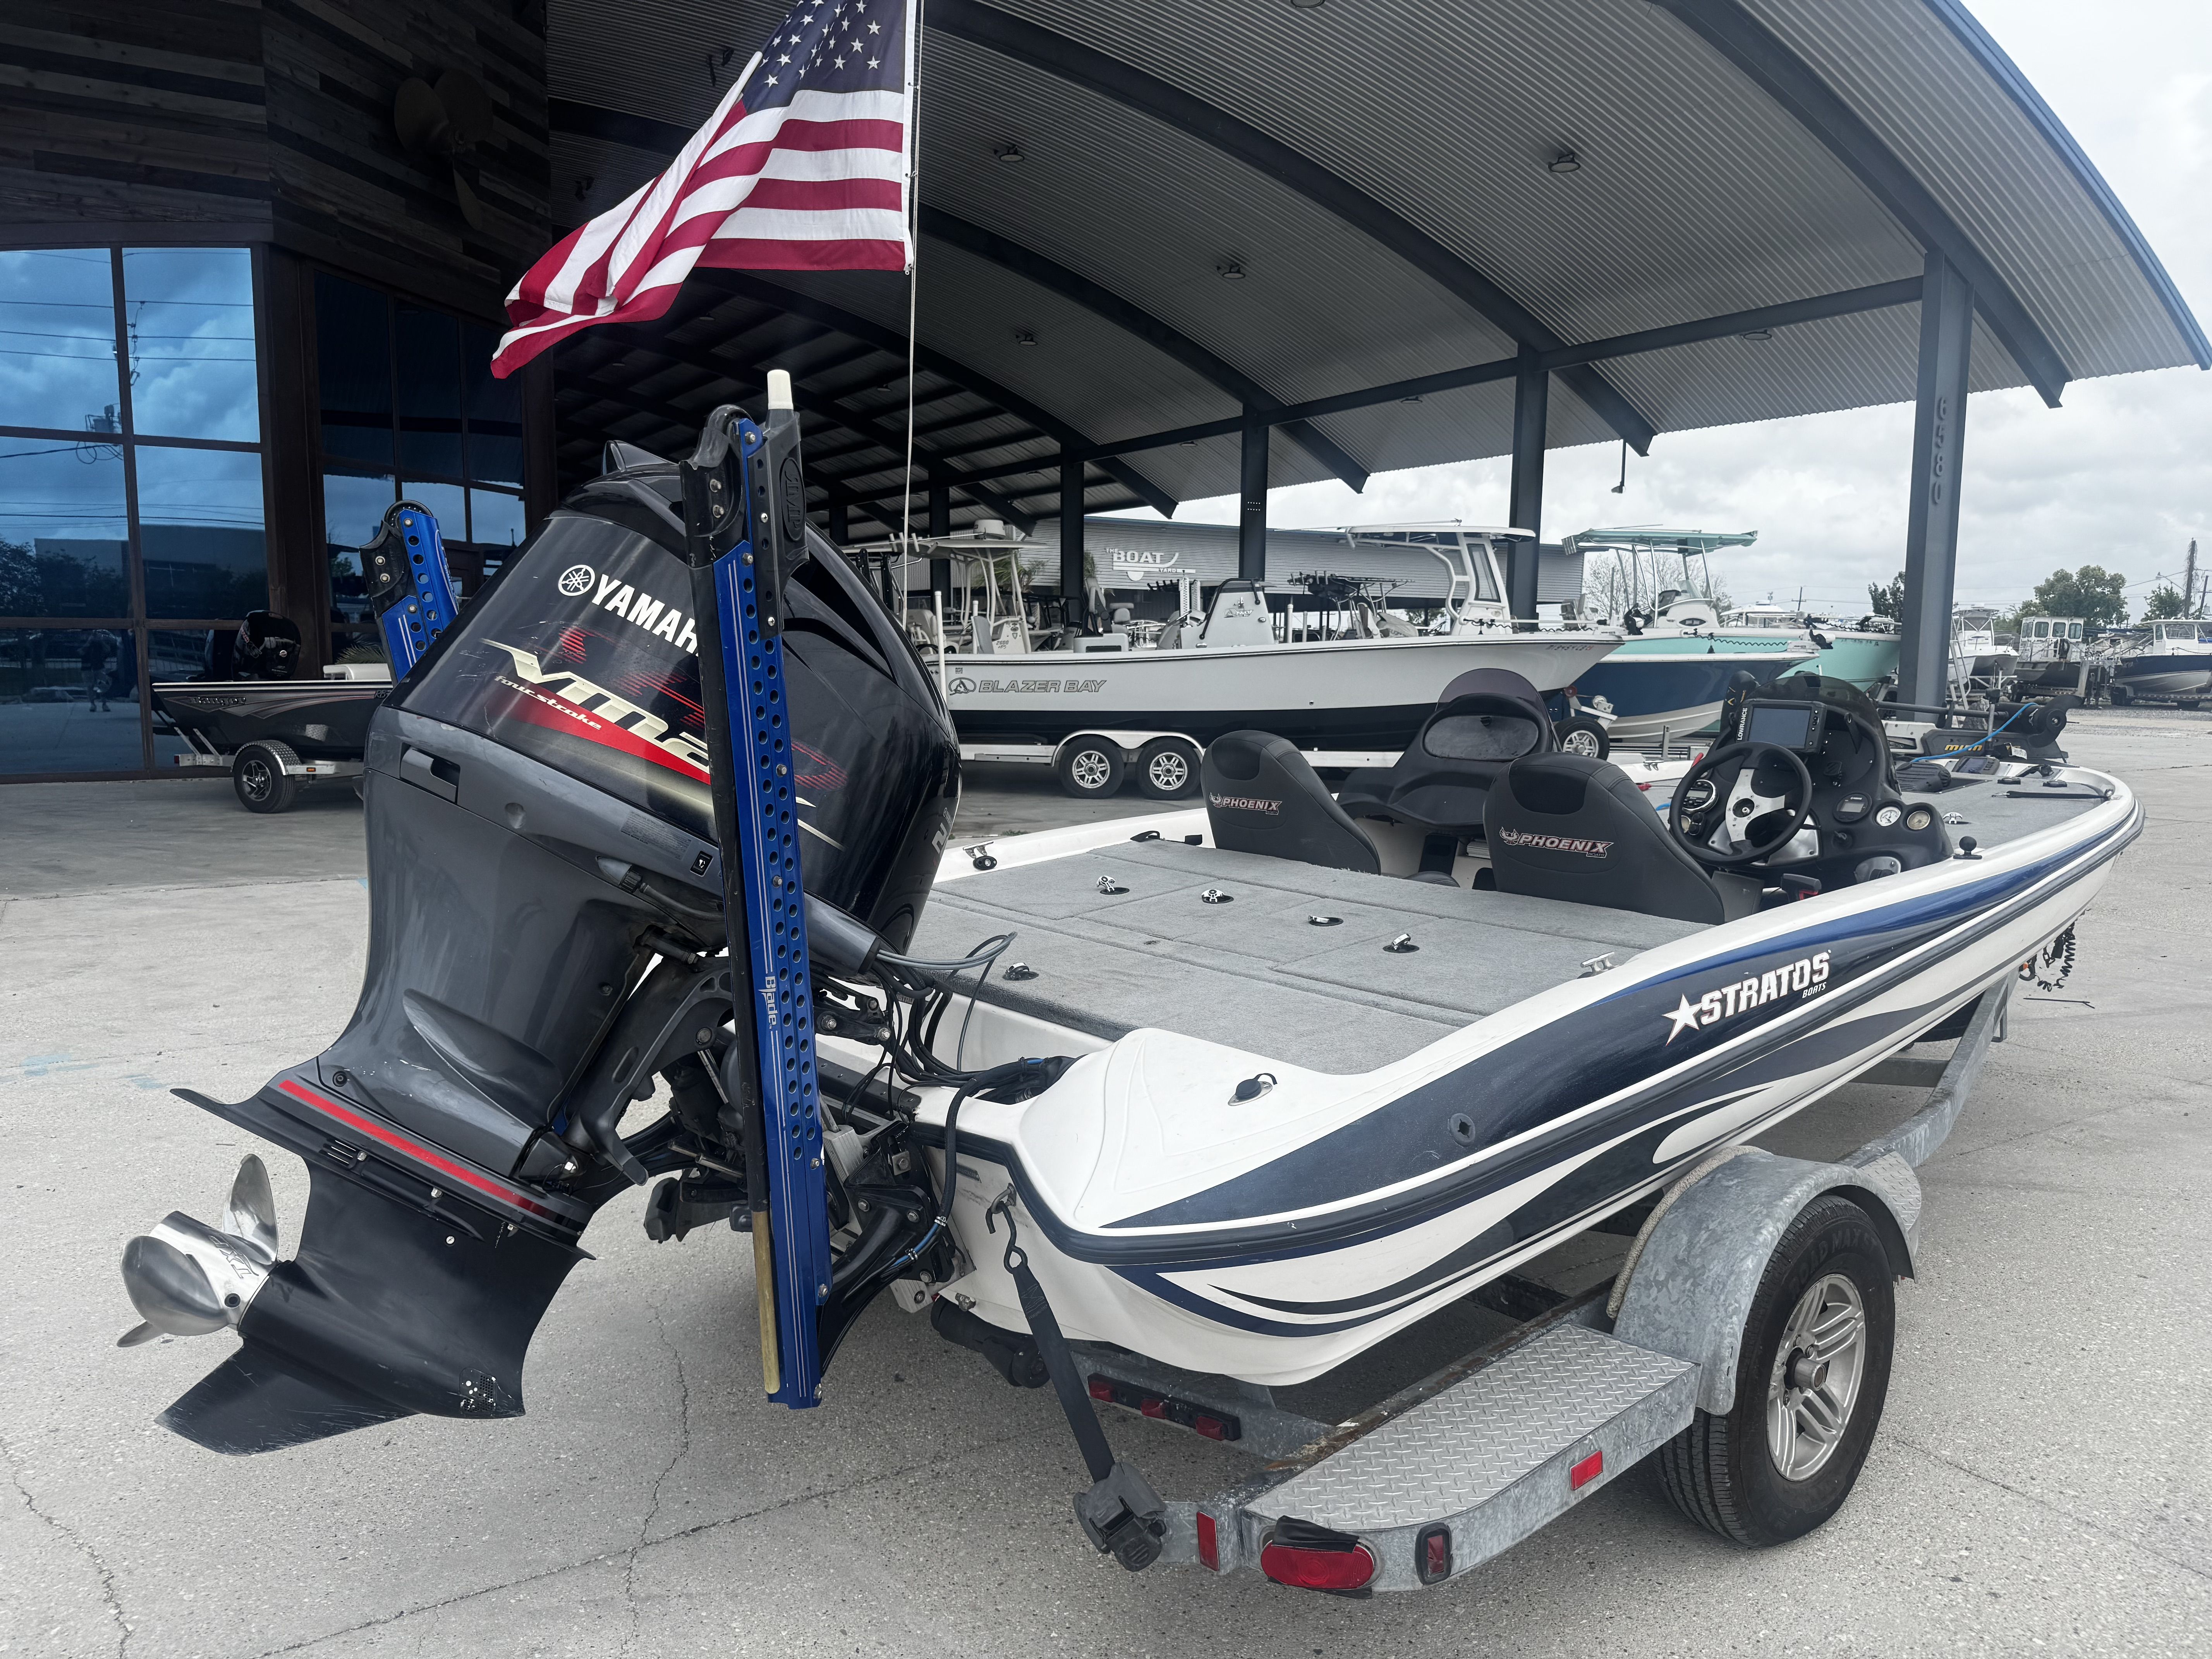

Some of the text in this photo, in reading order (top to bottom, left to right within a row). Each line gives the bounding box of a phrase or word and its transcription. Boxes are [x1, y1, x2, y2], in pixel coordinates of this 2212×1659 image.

[1932, 396, 1948, 505] 6580
[1113, 551, 1164, 564] BOAT
[591, 574, 699, 657] YAMAH
[978, 680, 1107, 693] BLAZER BAY
[1737, 708, 1748, 741] LOWRANCE
[1222, 797, 1280, 811] PHOENIX
[1517, 833, 1612, 853] PHOENIX
[1700, 951, 1830, 1025] STRATOS
[1802, 981, 1827, 999] BOATS
